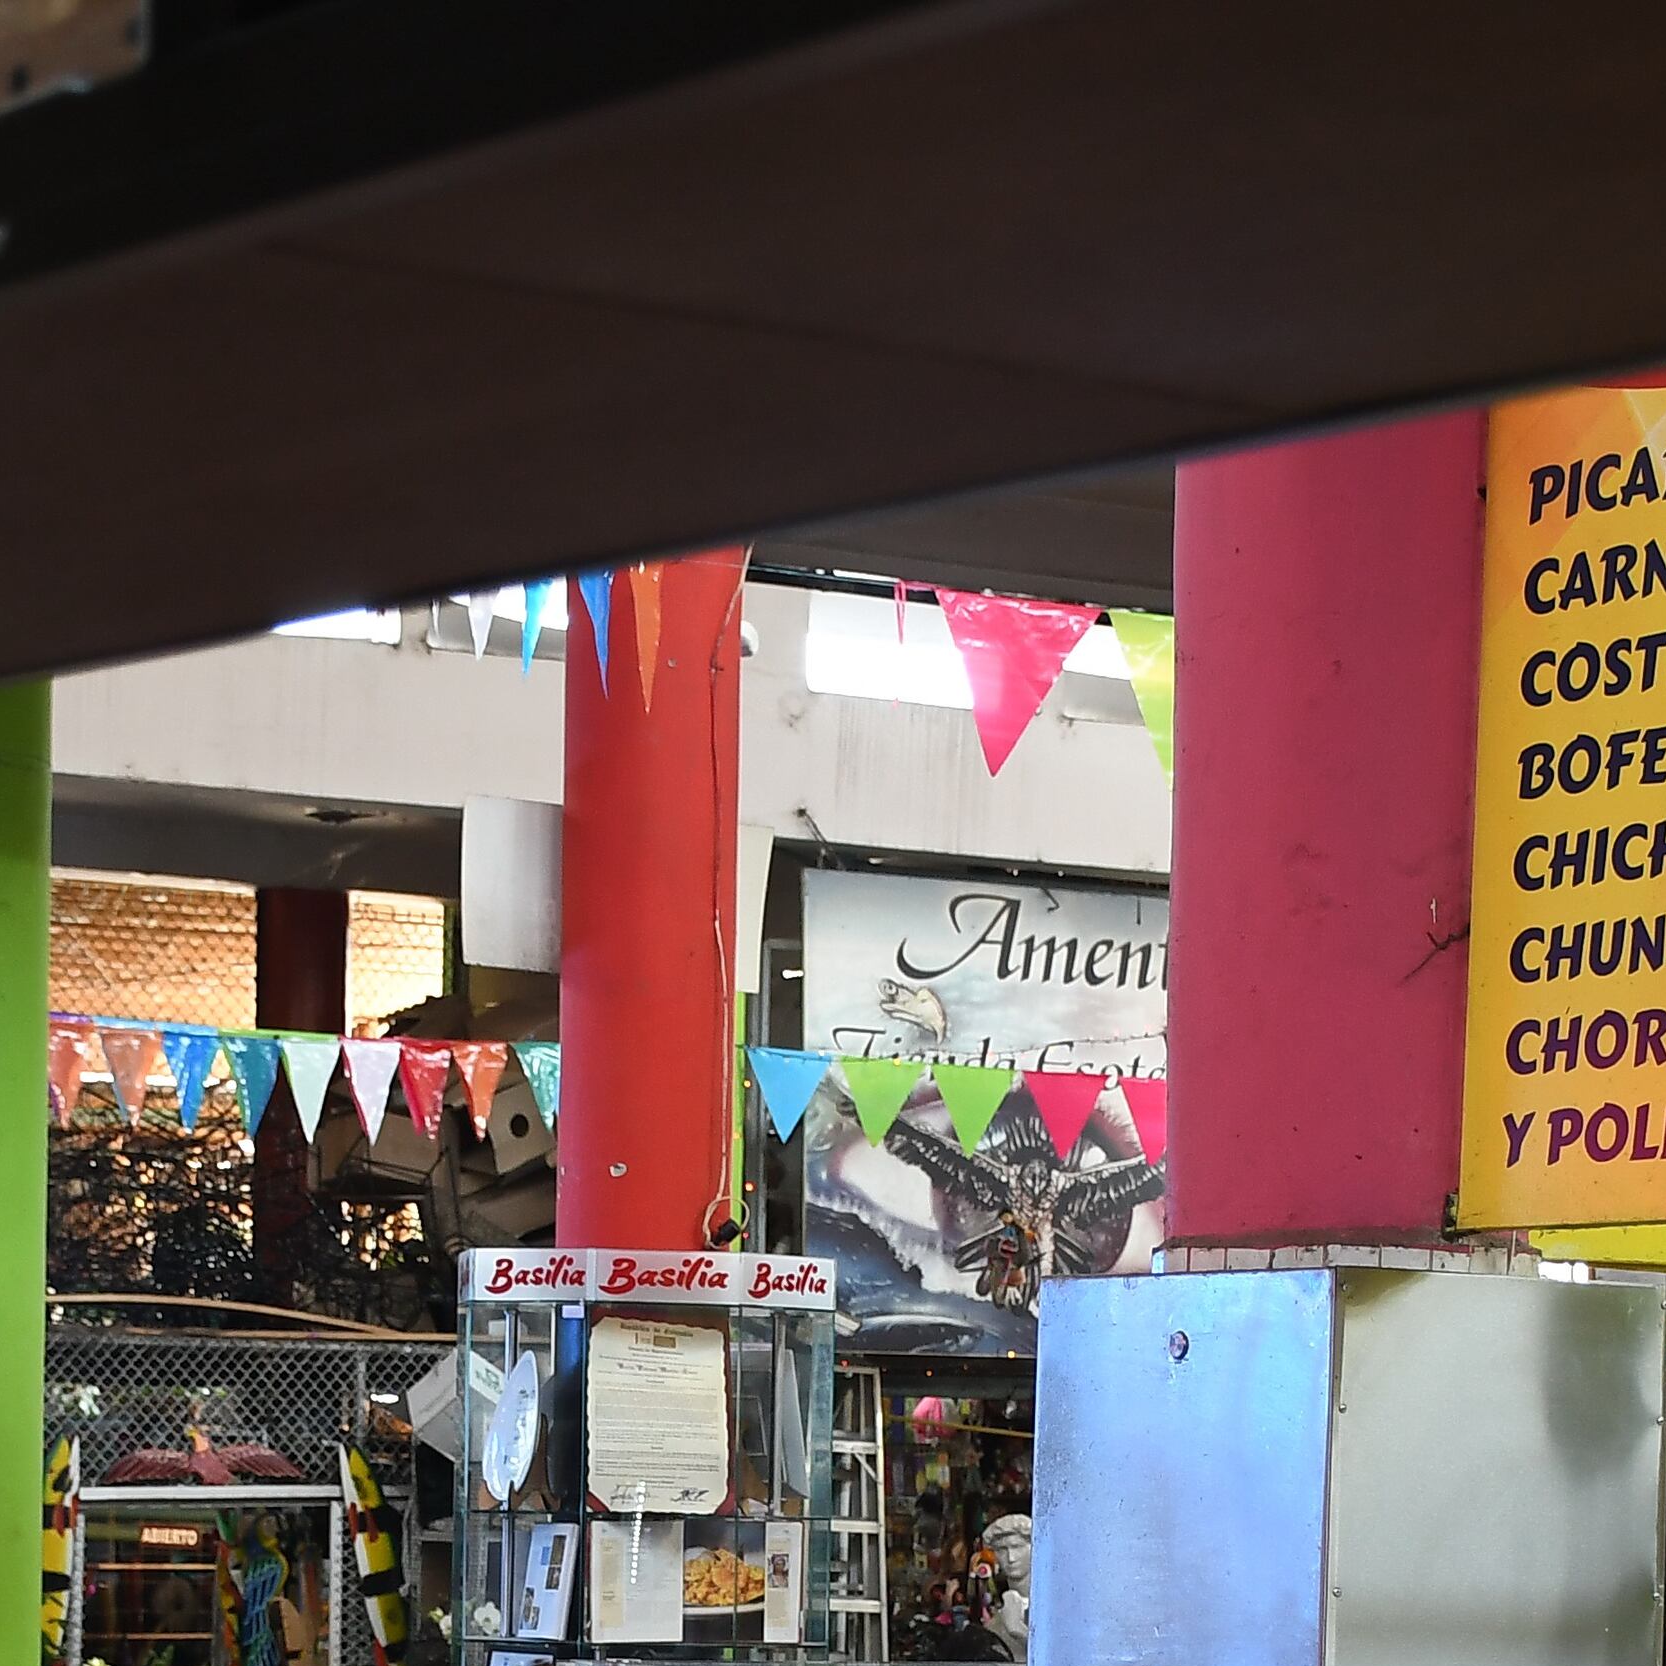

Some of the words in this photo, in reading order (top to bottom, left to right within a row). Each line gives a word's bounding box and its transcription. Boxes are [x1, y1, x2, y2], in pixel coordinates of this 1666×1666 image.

[1502, 1111, 1536, 1168] Y
[485, 1254, 587, 1295] Basilia
[598, 1256, 730, 1295] Basilia
[748, 1262, 828, 1299] Basilia
[140, 1527, 198, 1546] ABIERTO
